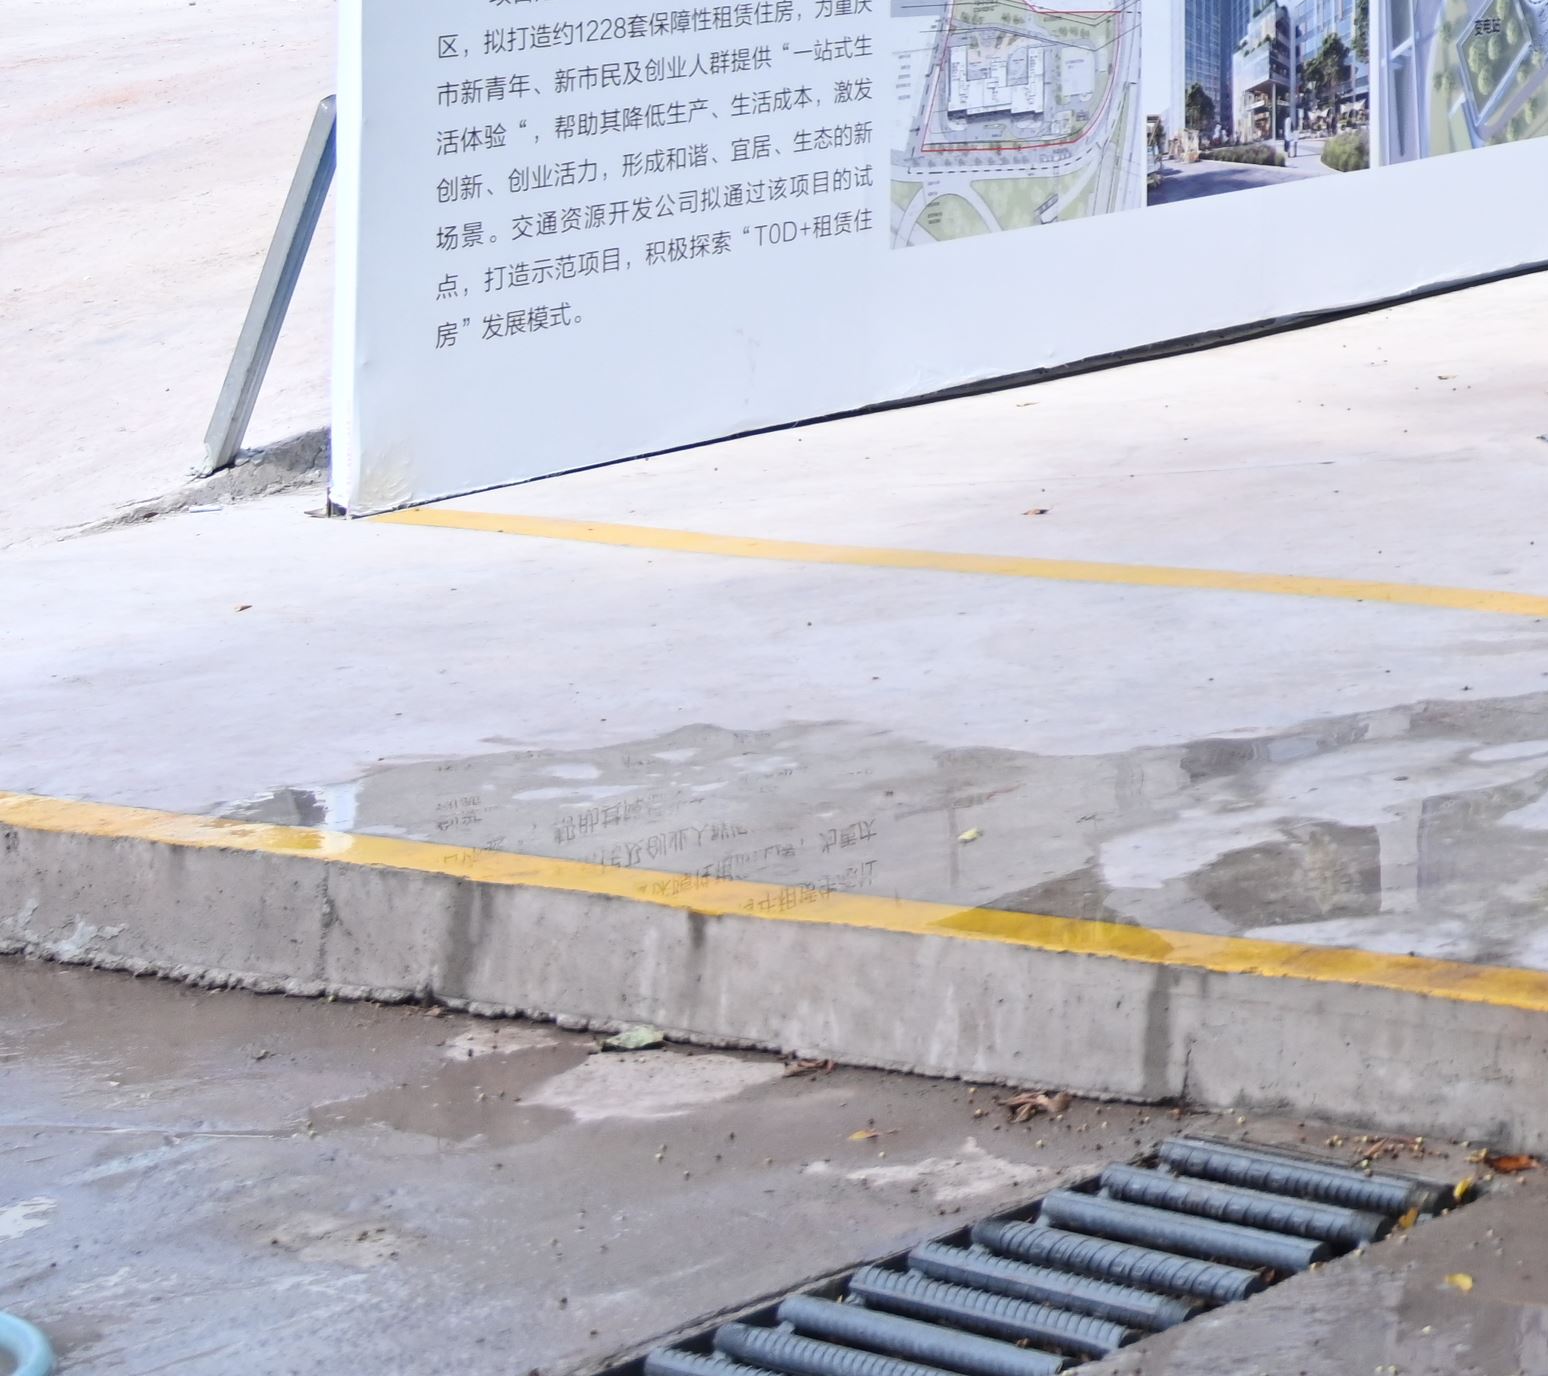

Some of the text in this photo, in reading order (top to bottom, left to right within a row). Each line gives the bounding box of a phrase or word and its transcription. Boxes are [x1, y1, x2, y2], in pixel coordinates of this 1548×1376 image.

[436, 121, 873, 204] 创新、创业活力，形成和谐、宜居、生态的新
[436, 164, 873, 251] 场景。交通资源开发公司拟通过该项目的试
